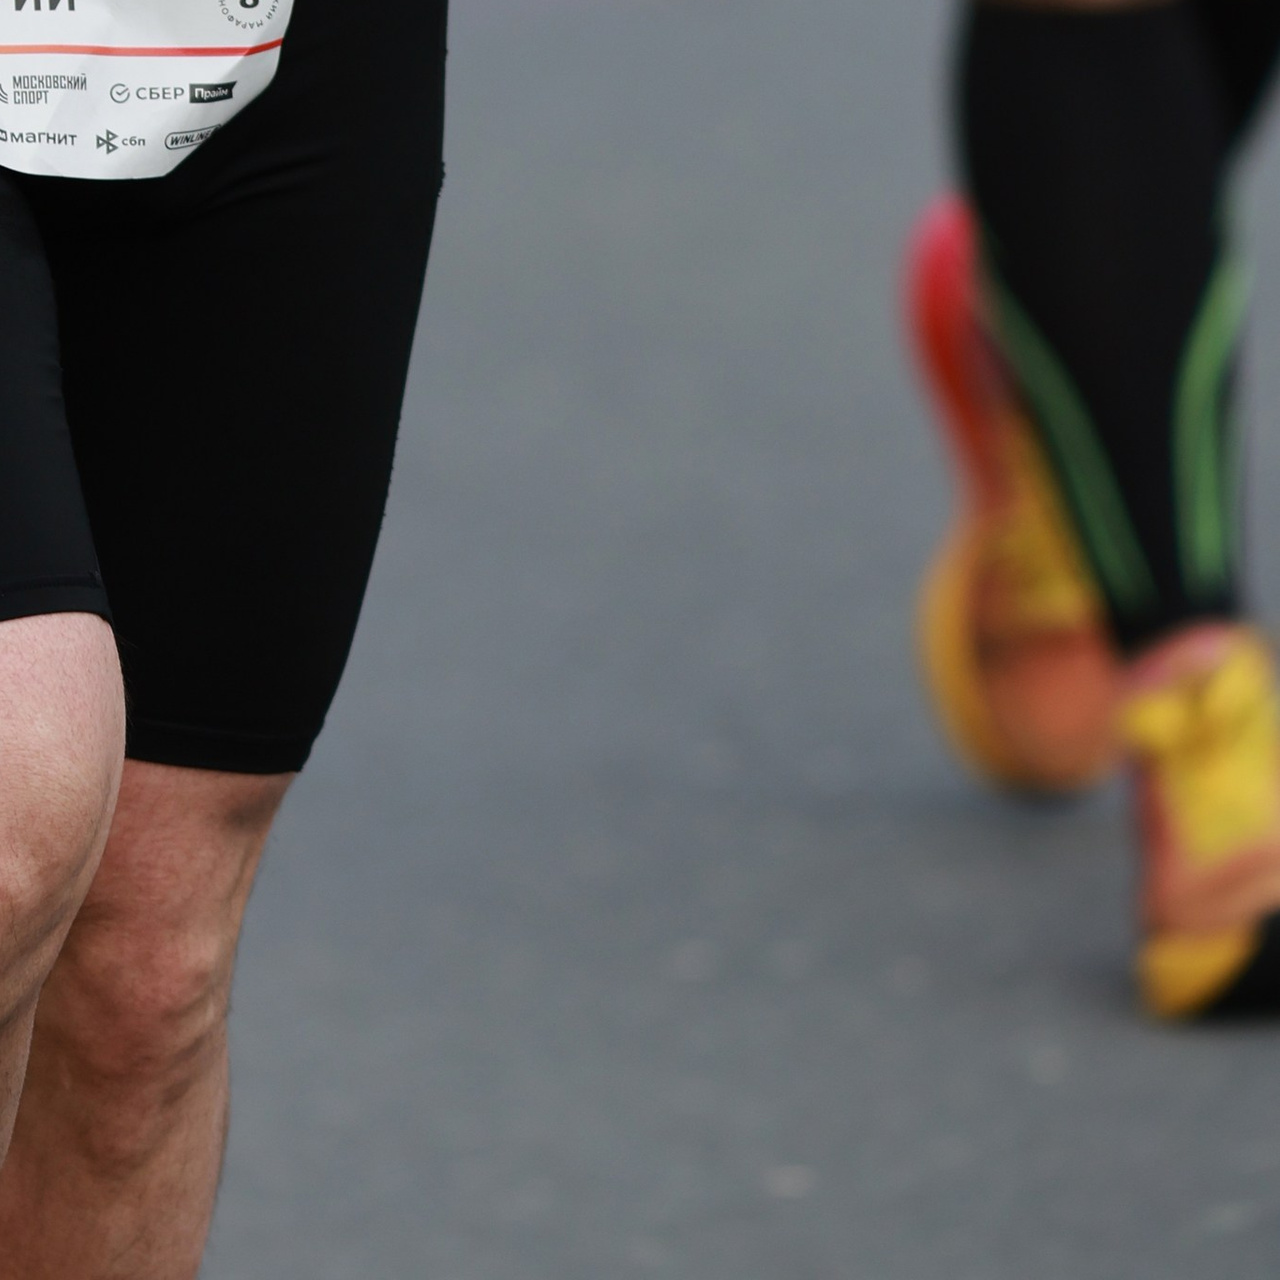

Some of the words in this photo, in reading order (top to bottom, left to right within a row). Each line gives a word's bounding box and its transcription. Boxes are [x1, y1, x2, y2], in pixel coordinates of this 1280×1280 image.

[218, 0, 264, 30] МАРАФОН
[12, 73, 87, 91] МОСКОВСКИЙ
[13, 90, 49, 105] СПОРТ
[136, 87, 184, 100] СБЕР
[194, 87, 229, 100] Прайм
[121, 135, 146, 147] сбп
